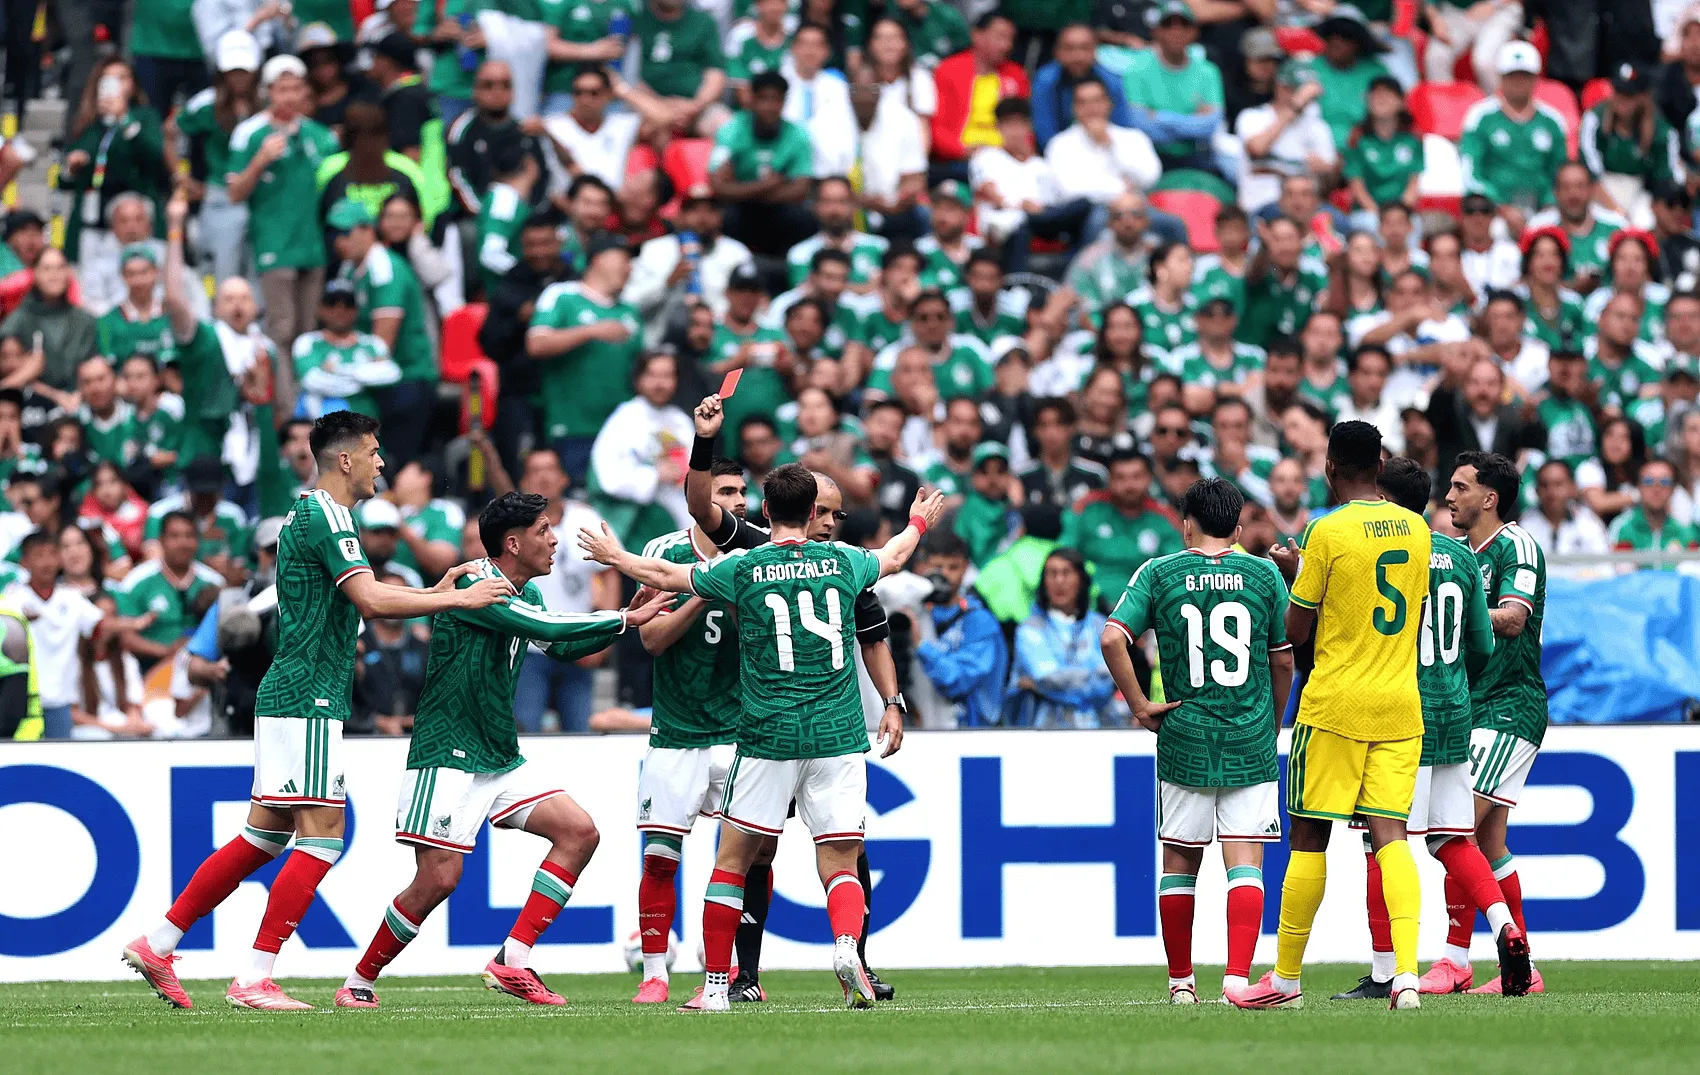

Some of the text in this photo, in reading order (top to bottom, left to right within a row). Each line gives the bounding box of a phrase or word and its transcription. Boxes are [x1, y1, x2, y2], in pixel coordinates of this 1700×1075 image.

[1363, 519, 1411, 539] MBATHA
[752, 558, 842, 583] A.GONZÁLEZ
[1185, 573, 1244, 592] G.MORA
[1372, 549, 1410, 636] 5
[704, 610, 723, 645] 5
[764, 587, 845, 672] 14
[1180, 601, 1252, 688] 19
